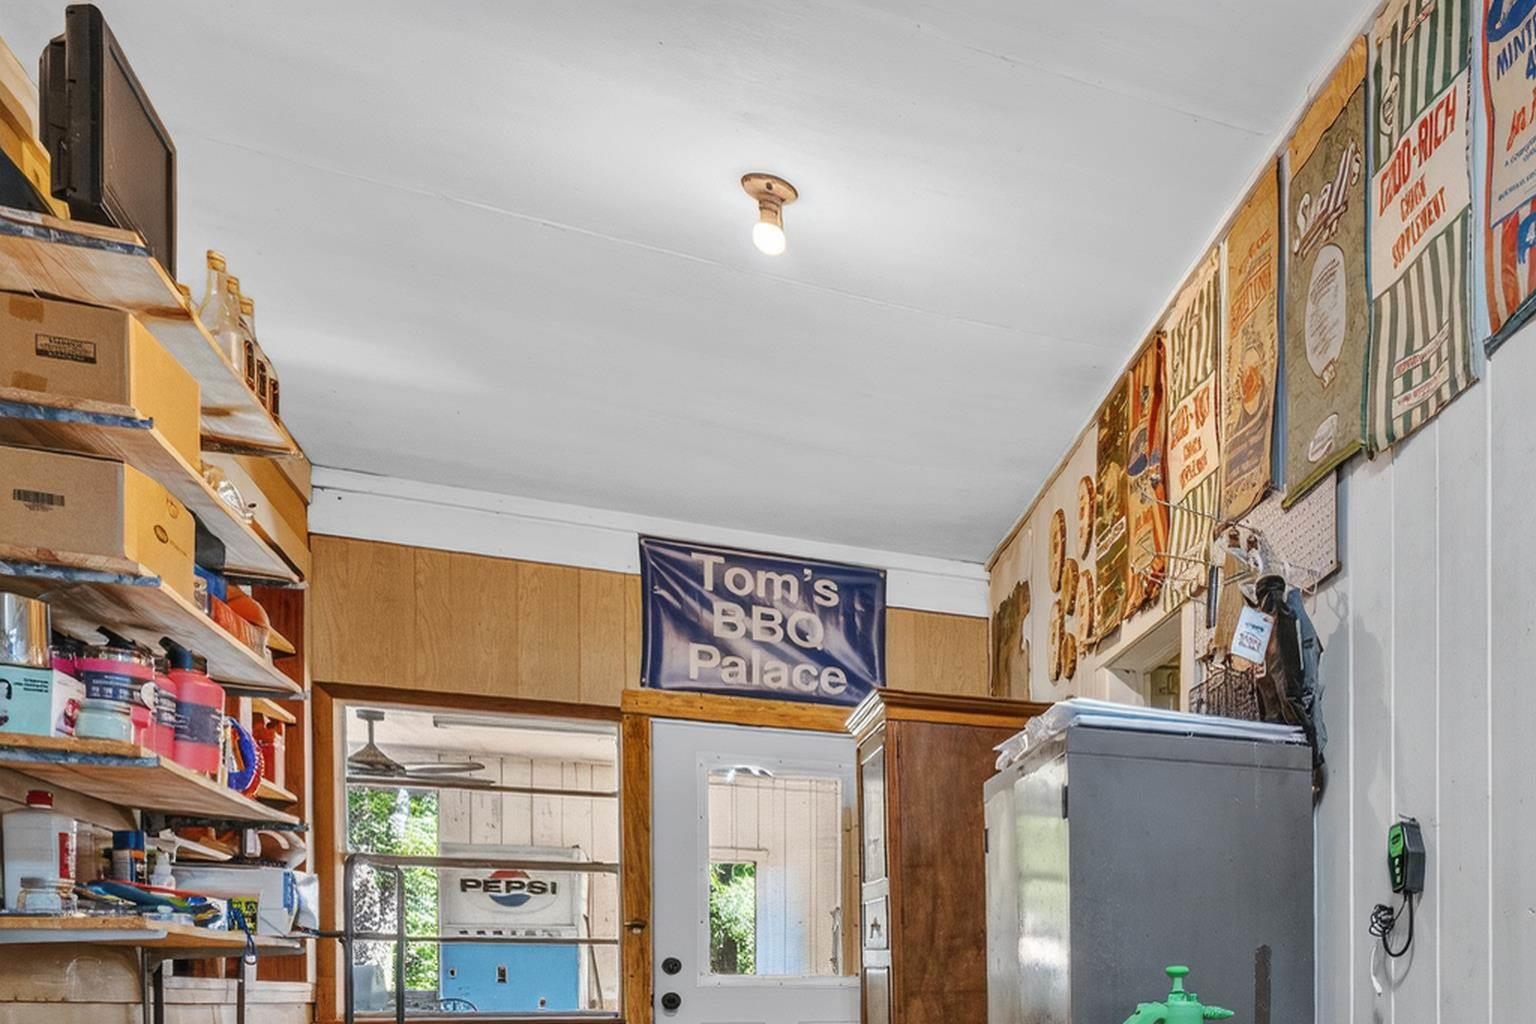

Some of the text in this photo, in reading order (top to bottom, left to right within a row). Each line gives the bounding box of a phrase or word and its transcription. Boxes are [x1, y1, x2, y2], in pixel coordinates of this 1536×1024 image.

[690, 552, 840, 607] Tom's
[711, 600, 825, 651] BBQ
[687, 642, 848, 696] Palace
[460, 878, 558, 895] PEPSI
